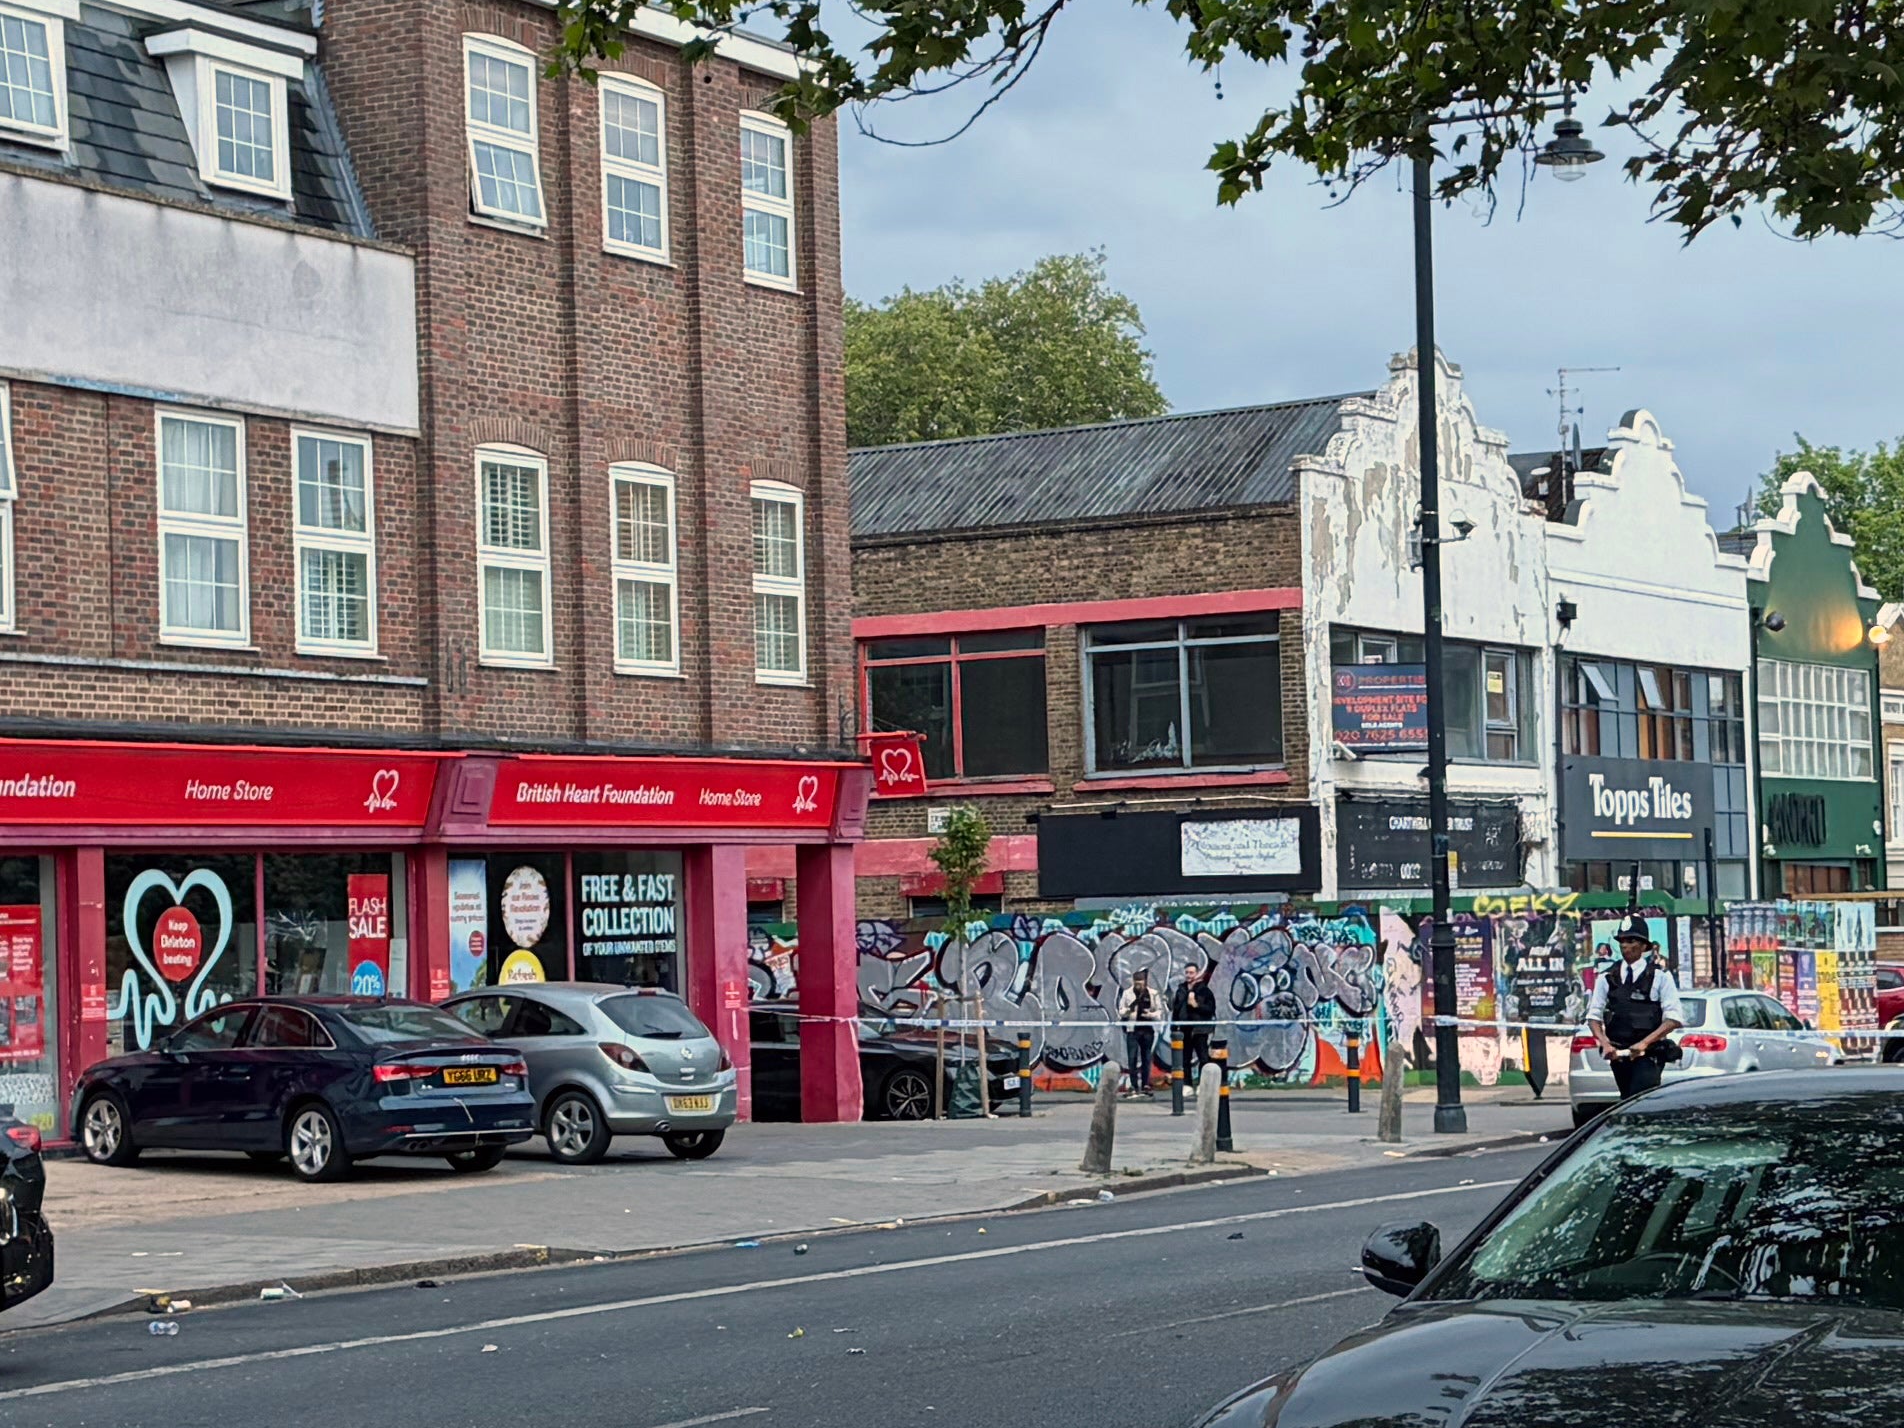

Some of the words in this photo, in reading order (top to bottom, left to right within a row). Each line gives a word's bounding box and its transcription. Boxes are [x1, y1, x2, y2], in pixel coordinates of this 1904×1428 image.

[185, 779, 227, 800] Home
[231, 781, 273, 801] Store
[517, 781, 559, 804] British
[563, 783, 599, 805] Heart
[603, 783, 674, 806] Foundation
[699, 788, 730, 805] Home
[733, 789, 762, 807] Store
[1589, 773, 1649, 825] Topps
[1649, 776, 1692, 819] Tiles
[581, 875, 620, 902] FREE
[622, 874, 636, 902] &
[637, 874, 675, 901] FAST
[348, 897, 387, 916] FLASH
[348, 917, 388, 939] SALE
[582, 907, 675, 936] COLLECTION
[1516, 957, 1546, 972] ALL
[1549, 957, 1565, 972] IN
[352, 975, 381, 996] 20%
